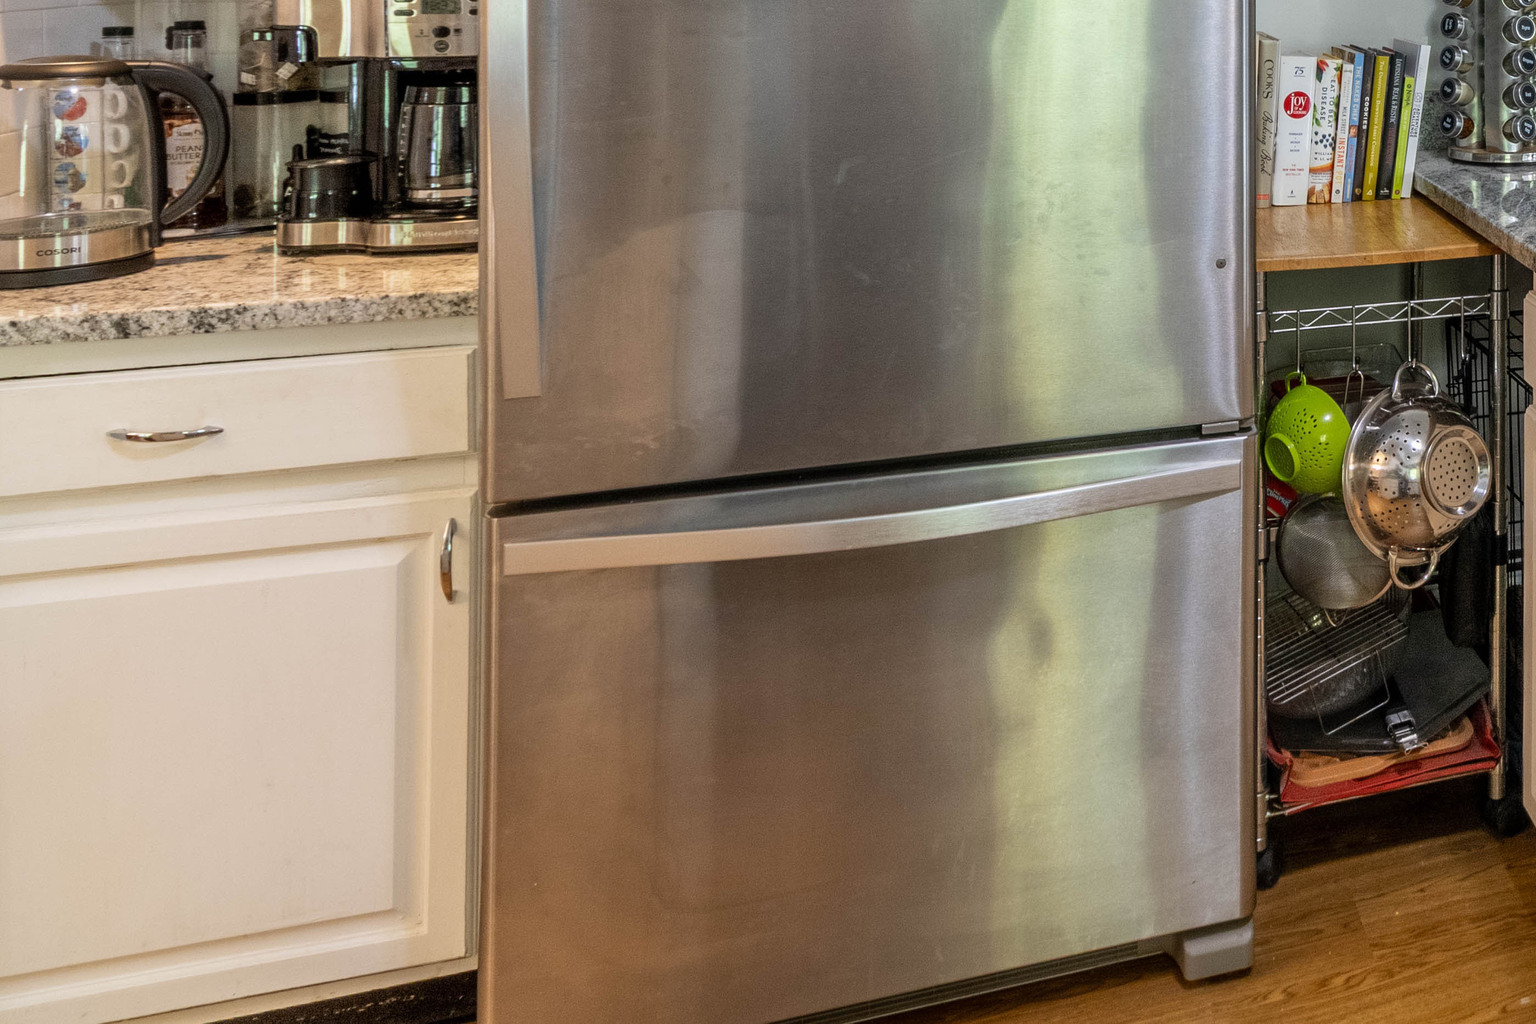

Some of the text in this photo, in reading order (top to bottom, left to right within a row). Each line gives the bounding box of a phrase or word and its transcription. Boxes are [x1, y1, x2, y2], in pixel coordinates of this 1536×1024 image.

[1287, 93, 1307, 115] joy
[1320, 87, 1328, 121] DISEASE
[1329, 96, 1335, 106] TO
[1362, 96, 1370, 130] COOKIES
[1336, 137, 1346, 168] INSTANT
[36, 247, 81, 257] COSORI
